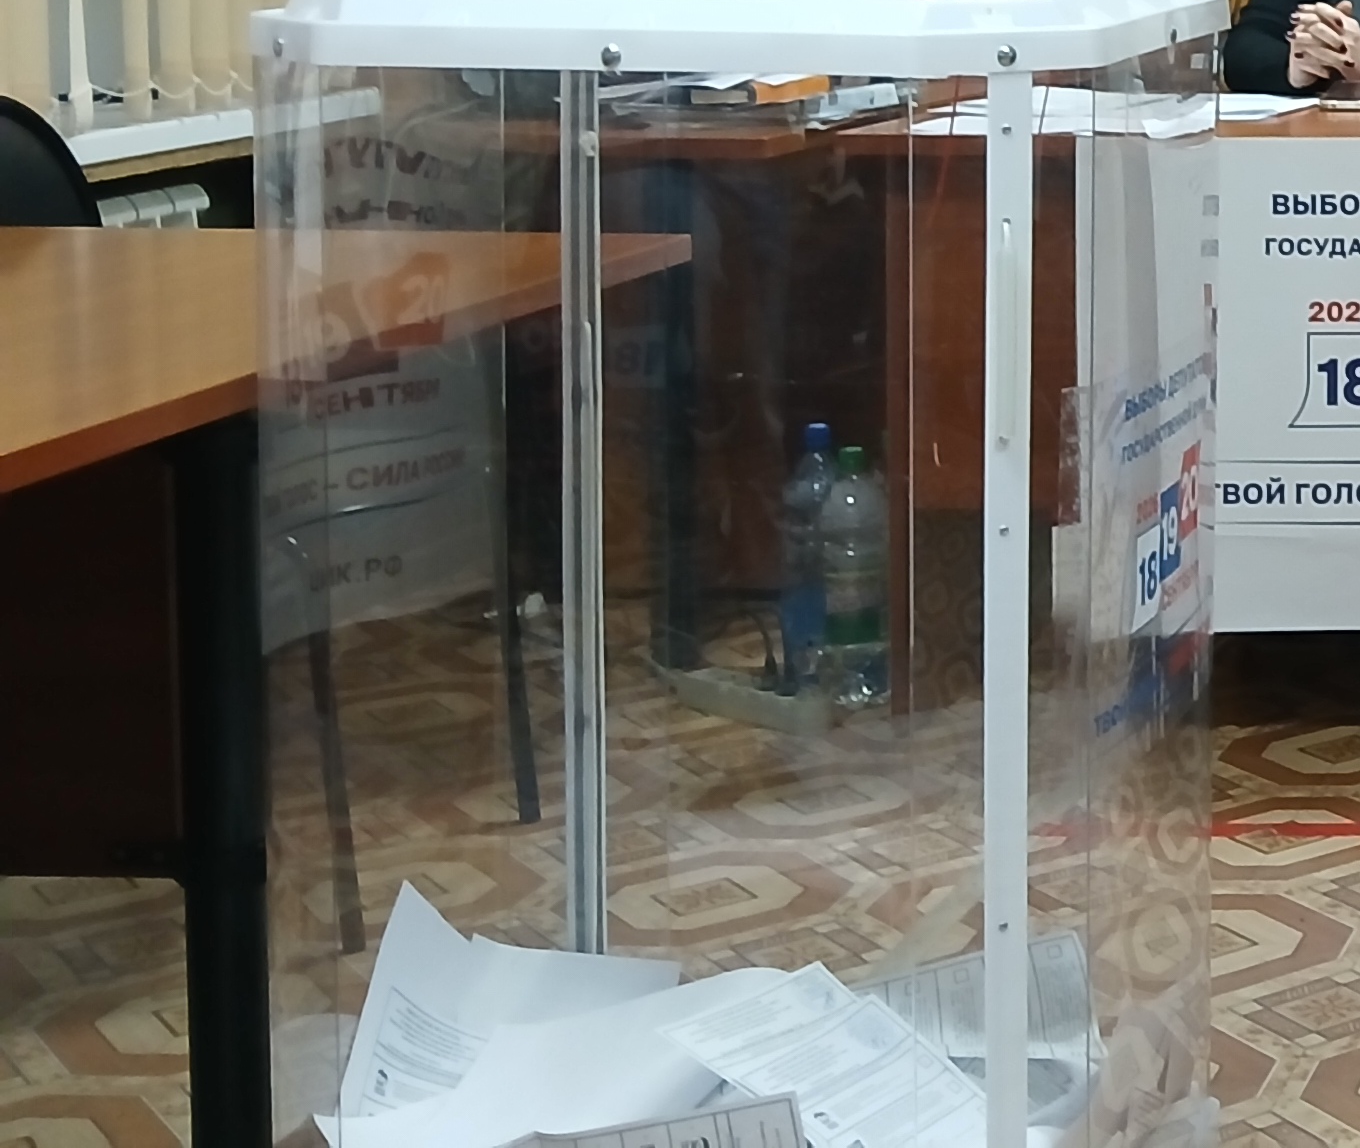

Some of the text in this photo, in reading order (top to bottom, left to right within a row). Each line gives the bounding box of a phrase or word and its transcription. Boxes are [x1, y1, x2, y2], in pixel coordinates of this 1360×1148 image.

[1181, 464, 1198, 521] 20
[1214, 477, 1286, 505] ВОЙ
[1162, 505, 1179, 561] 19
[1138, 550, 1158, 606] 18
